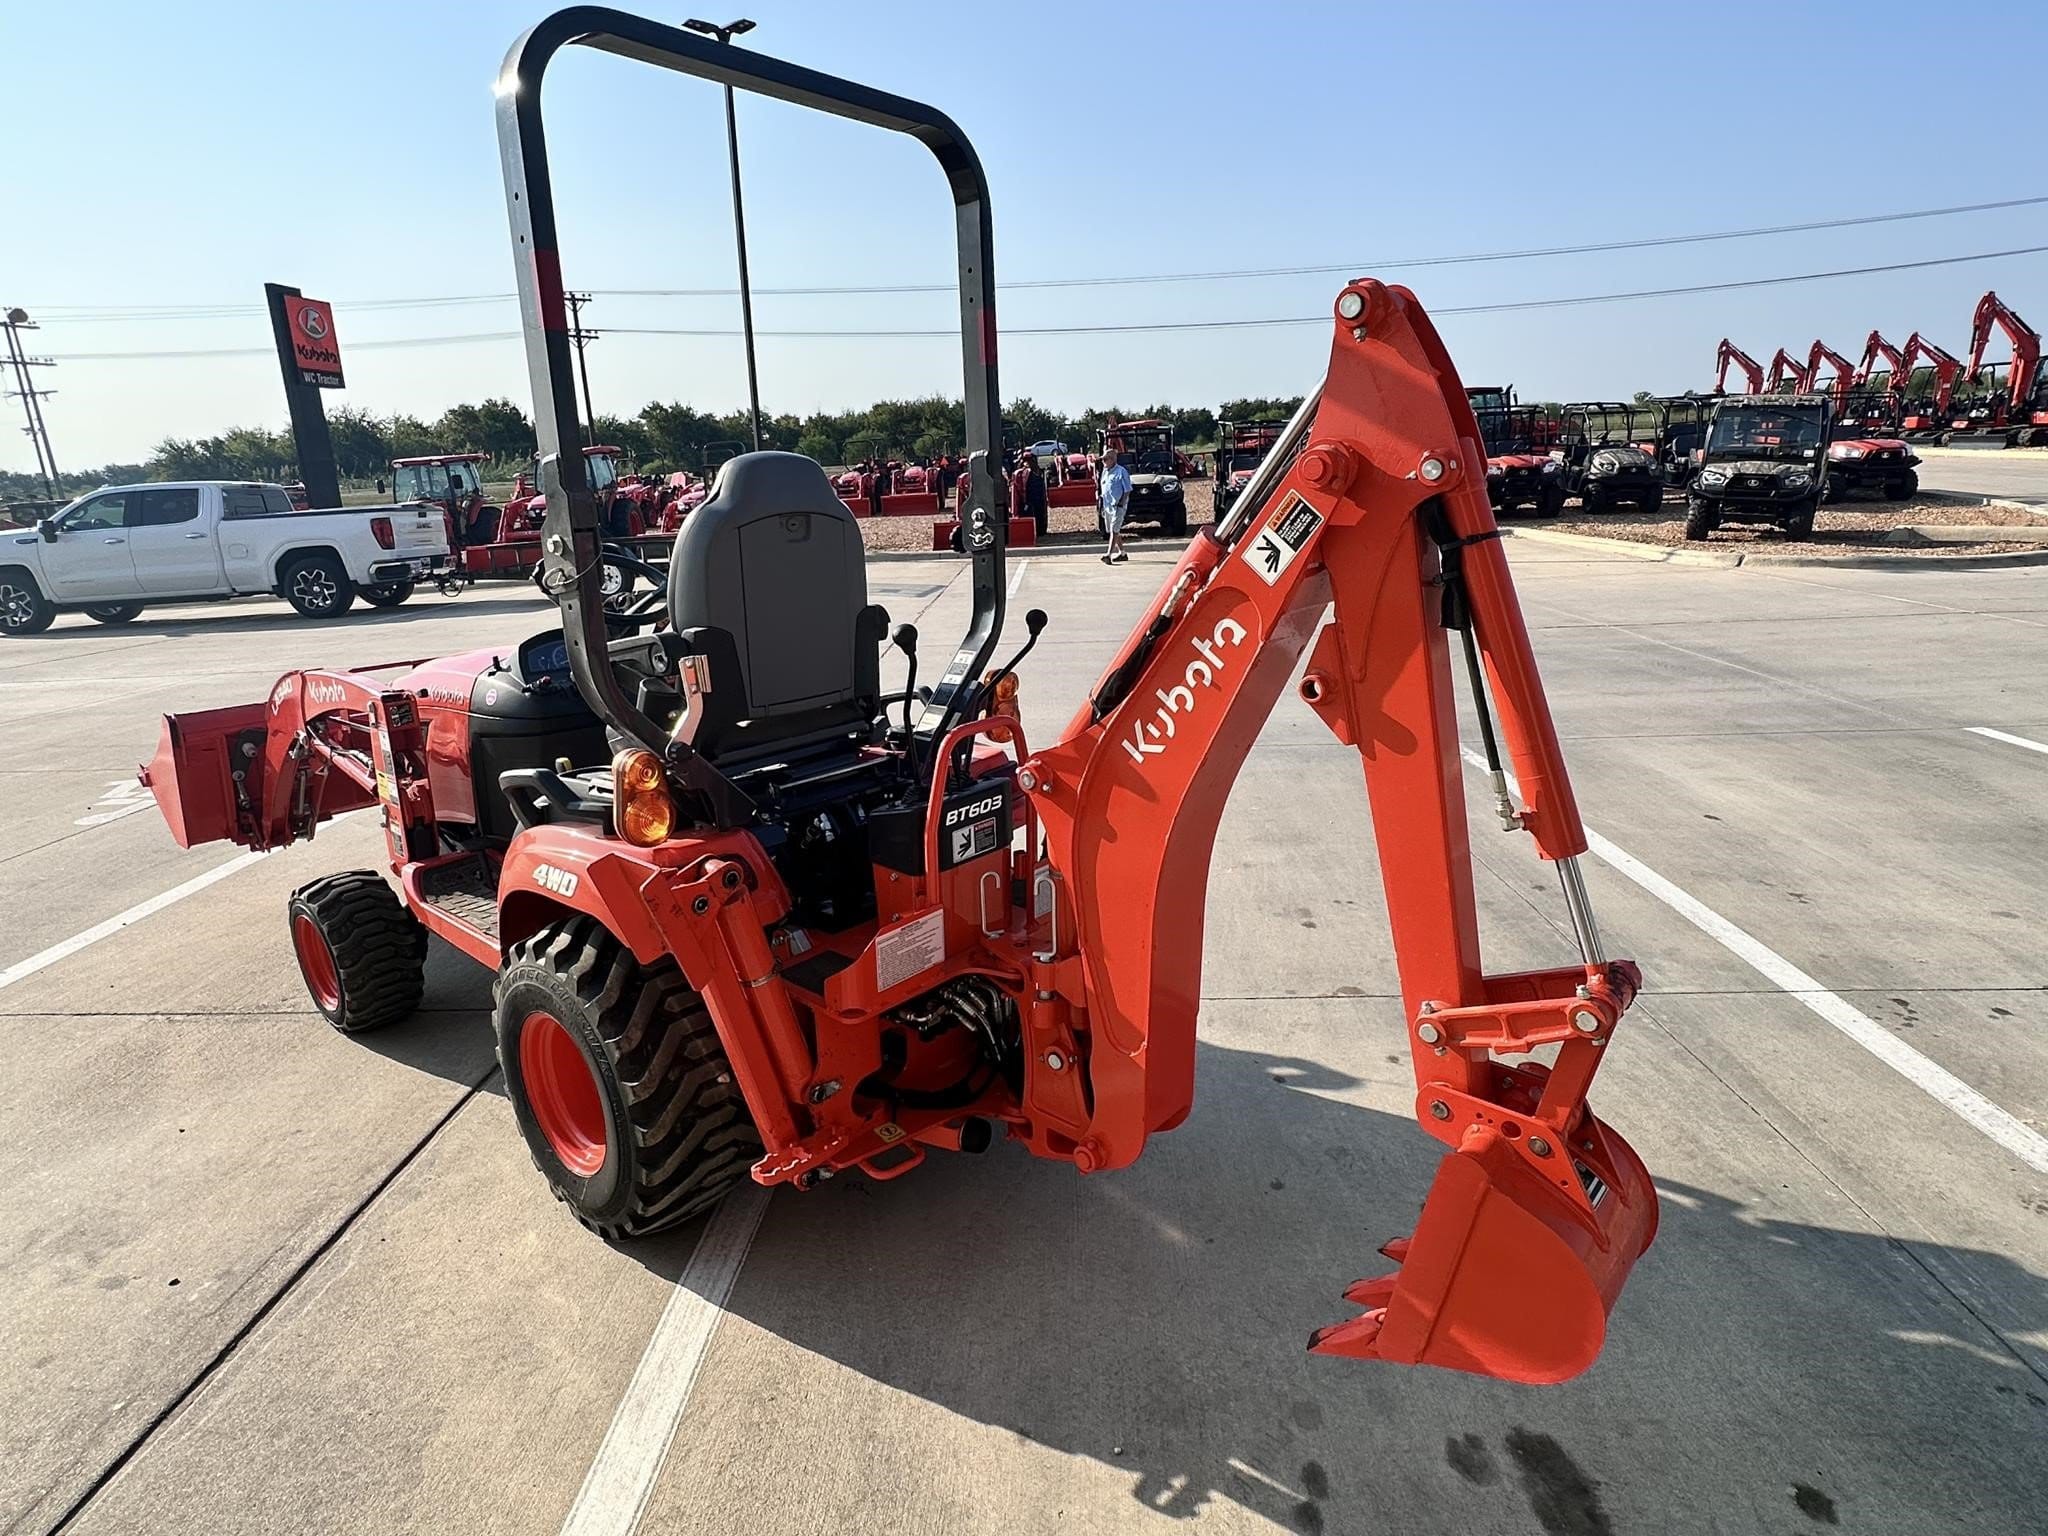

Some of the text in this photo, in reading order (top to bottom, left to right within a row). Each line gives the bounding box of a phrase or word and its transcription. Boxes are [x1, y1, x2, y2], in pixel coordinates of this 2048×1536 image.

[297, 344, 338, 364] Kubota
[303, 372, 339, 385] WC Tractor
[307, 679, 346, 704] Kubota
[429, 684, 464, 705] Kubota
[1121, 617, 1248, 764] Kubota
[945, 794, 1003, 826] BT603
[532, 863, 579, 898] 4WD
